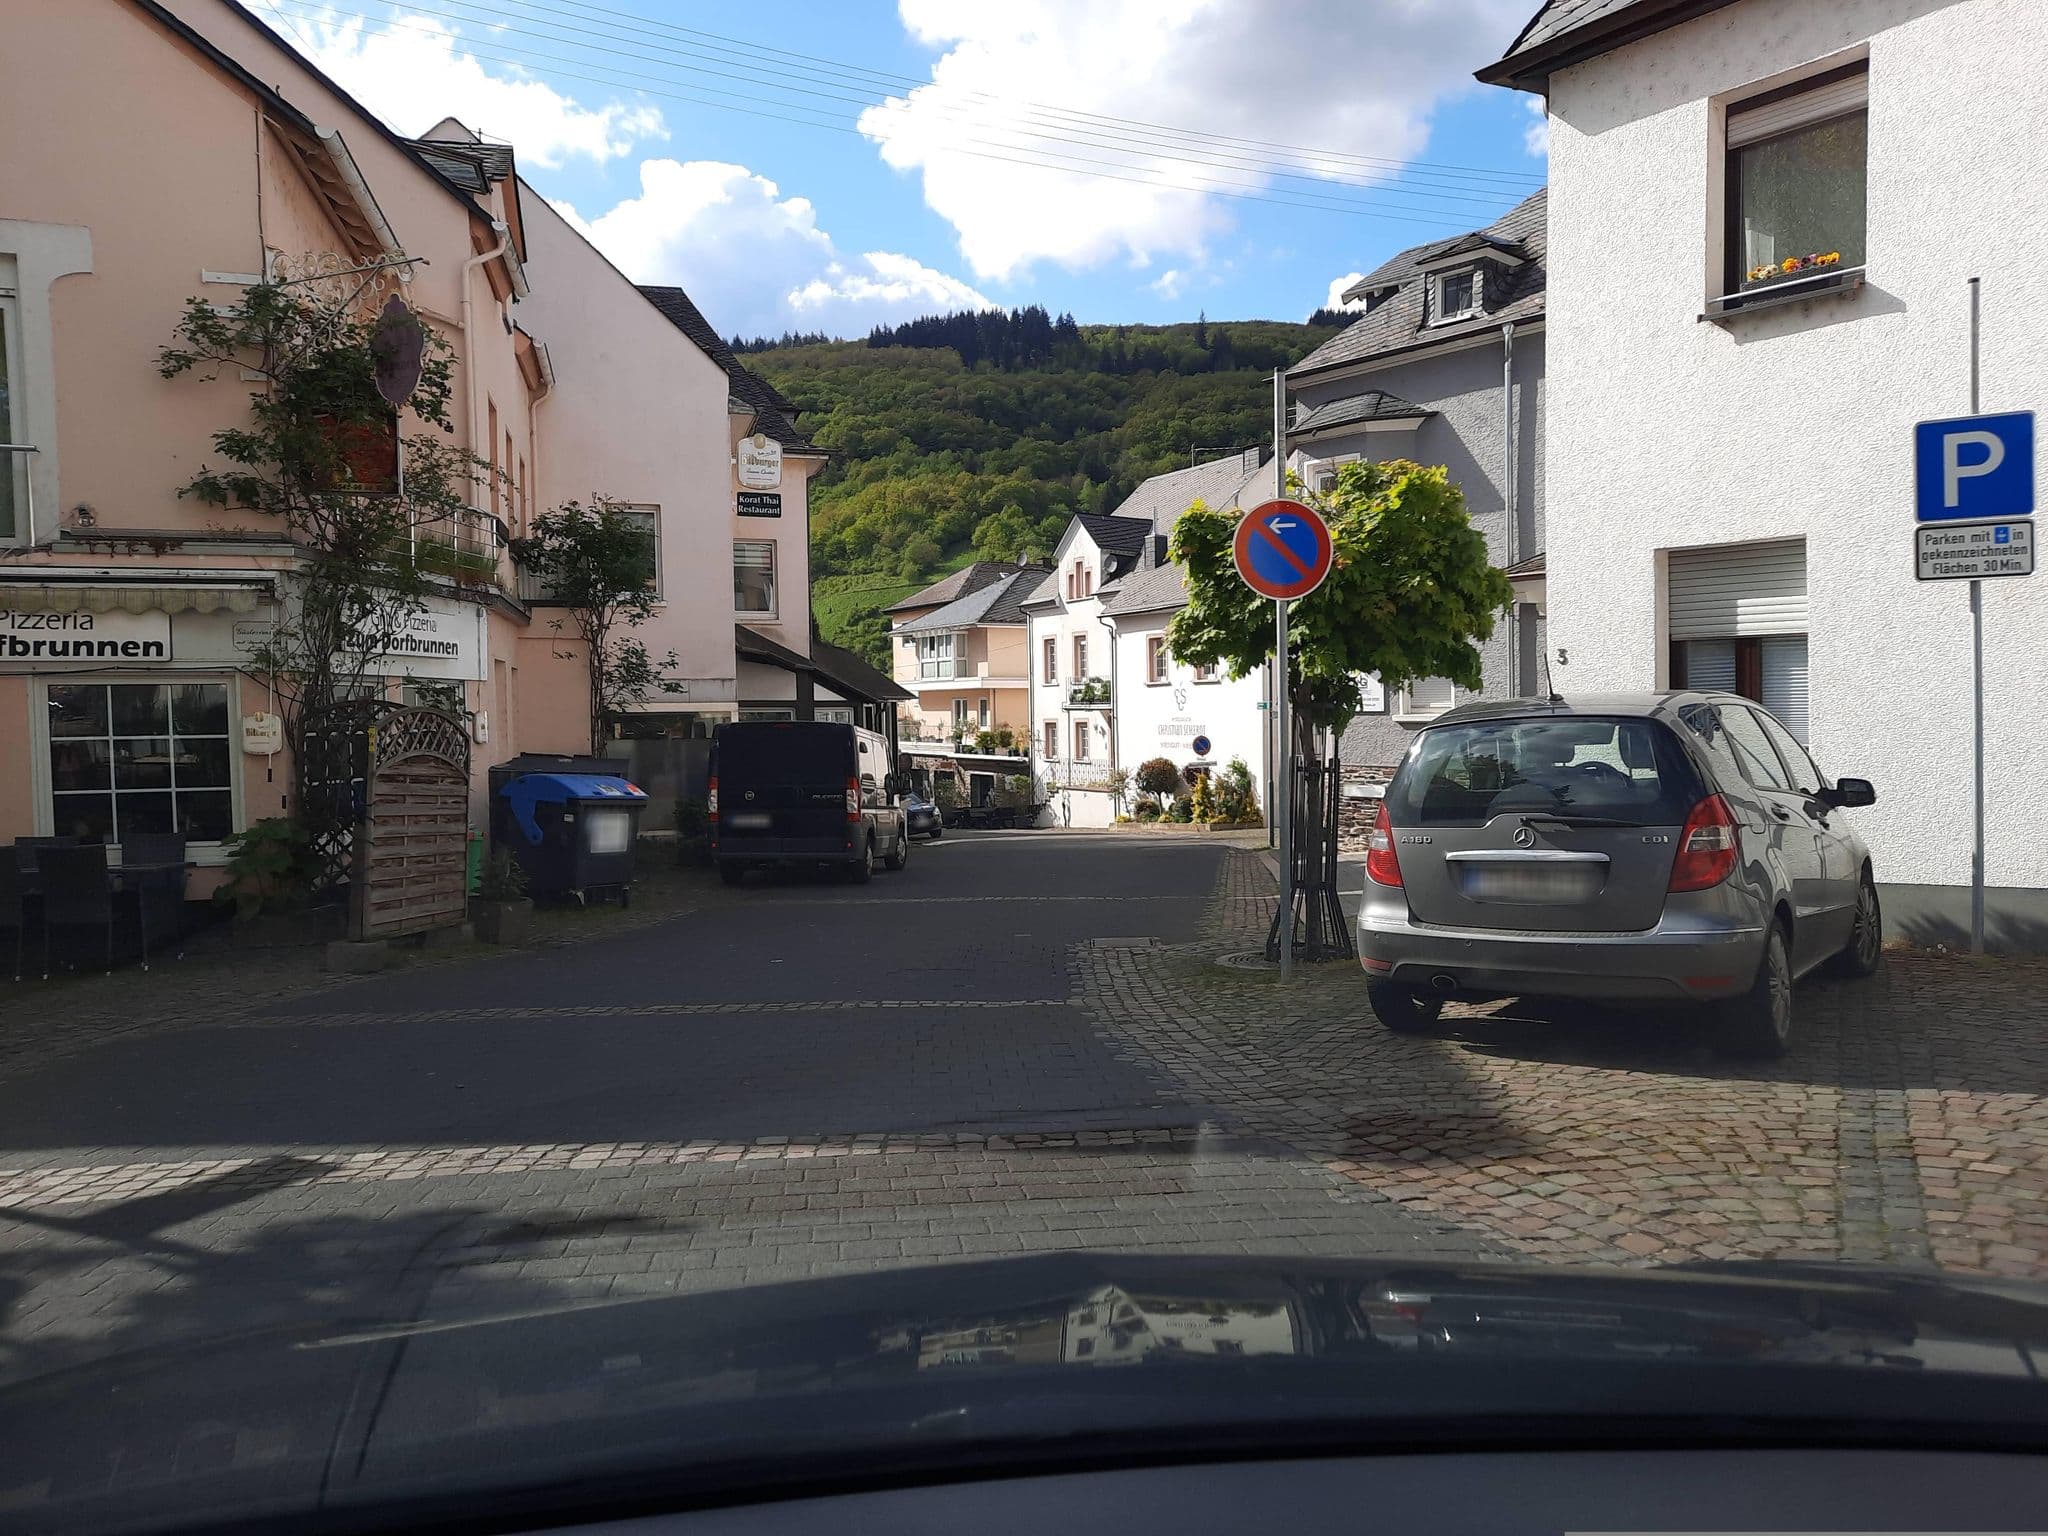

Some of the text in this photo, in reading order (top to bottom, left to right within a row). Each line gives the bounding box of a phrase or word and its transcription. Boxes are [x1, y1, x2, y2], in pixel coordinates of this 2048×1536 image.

[1943, 430, 2005, 507] P
[739, 495, 779, 505] Korat Thai
[738, 505, 780, 514] Restaurant
[1925, 528, 2024, 545] Parken mit in
[1921, 545, 2027, 563] gekennzeichneten
[1932, 561, 1978, 574] Flächen
[1983, 560, 1998, 572] 30
[0, 609, 94, 630] Pizzeria
[382, 631, 459, 656] Dorfbrunnen
[1557, 648, 1569, 666] 3
